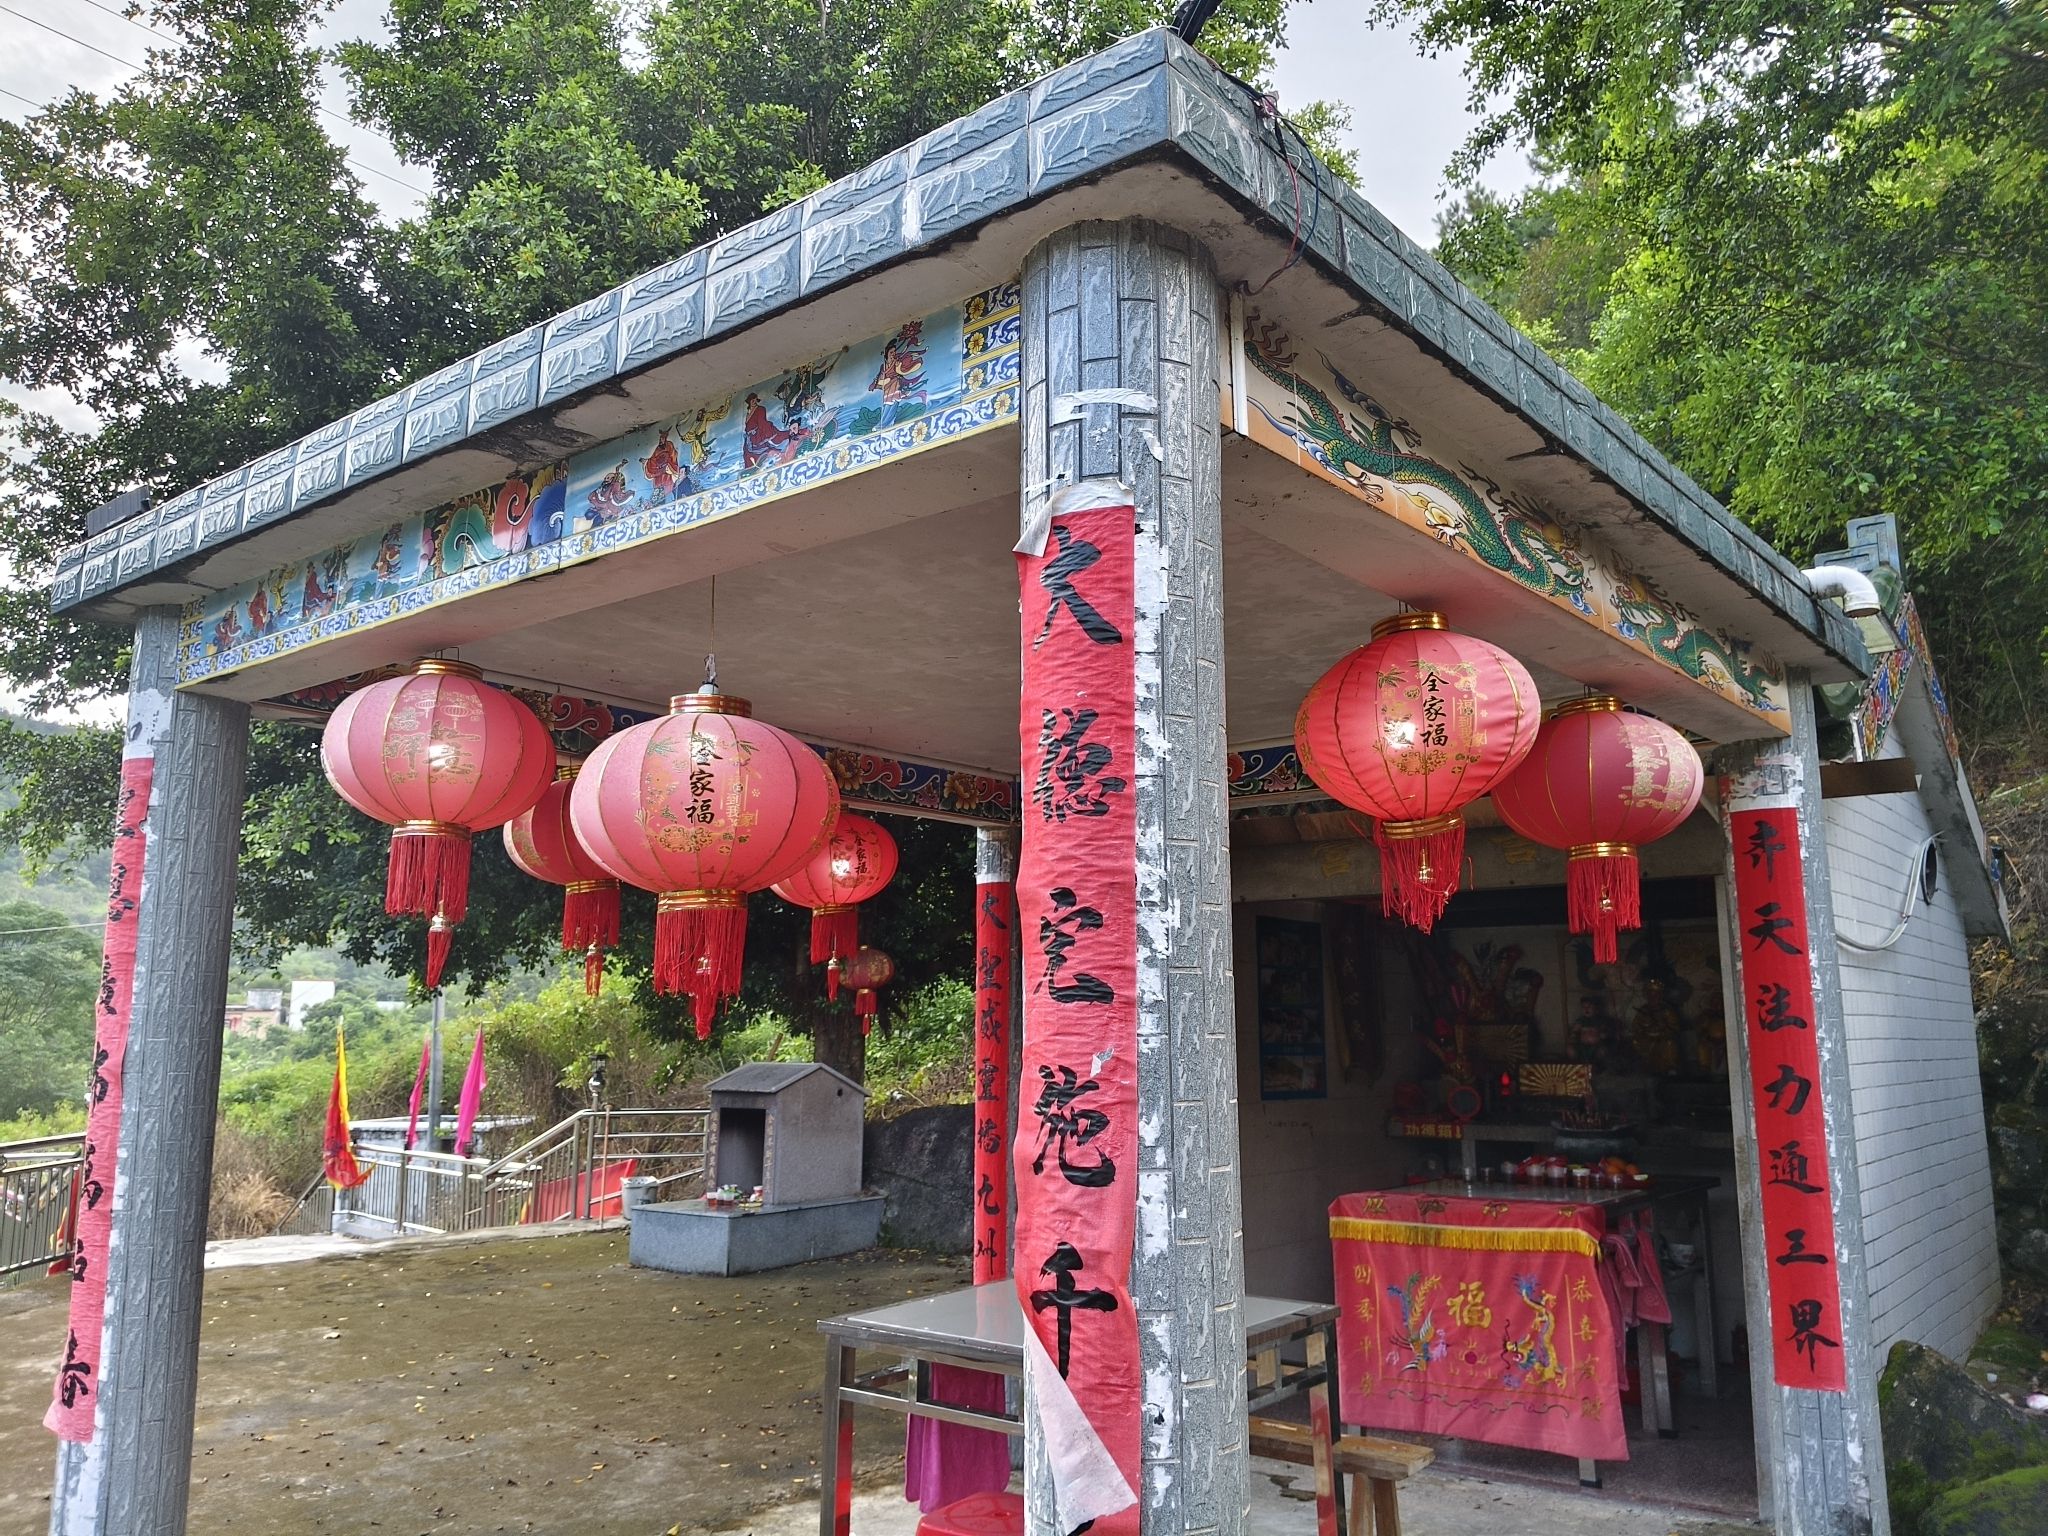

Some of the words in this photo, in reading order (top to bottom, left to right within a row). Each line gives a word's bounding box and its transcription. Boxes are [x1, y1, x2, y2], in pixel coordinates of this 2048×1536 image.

[1419, 672, 1450, 748] 全家福
[685, 747, 723, 824] 全家福
[854, 835, 868, 875] 全家福
[1029, 524, 1127, 1536] 大德宏施千
[1353, 1264, 1374, 1398] 四季平安
[1447, 1281, 1493, 1329] 福
